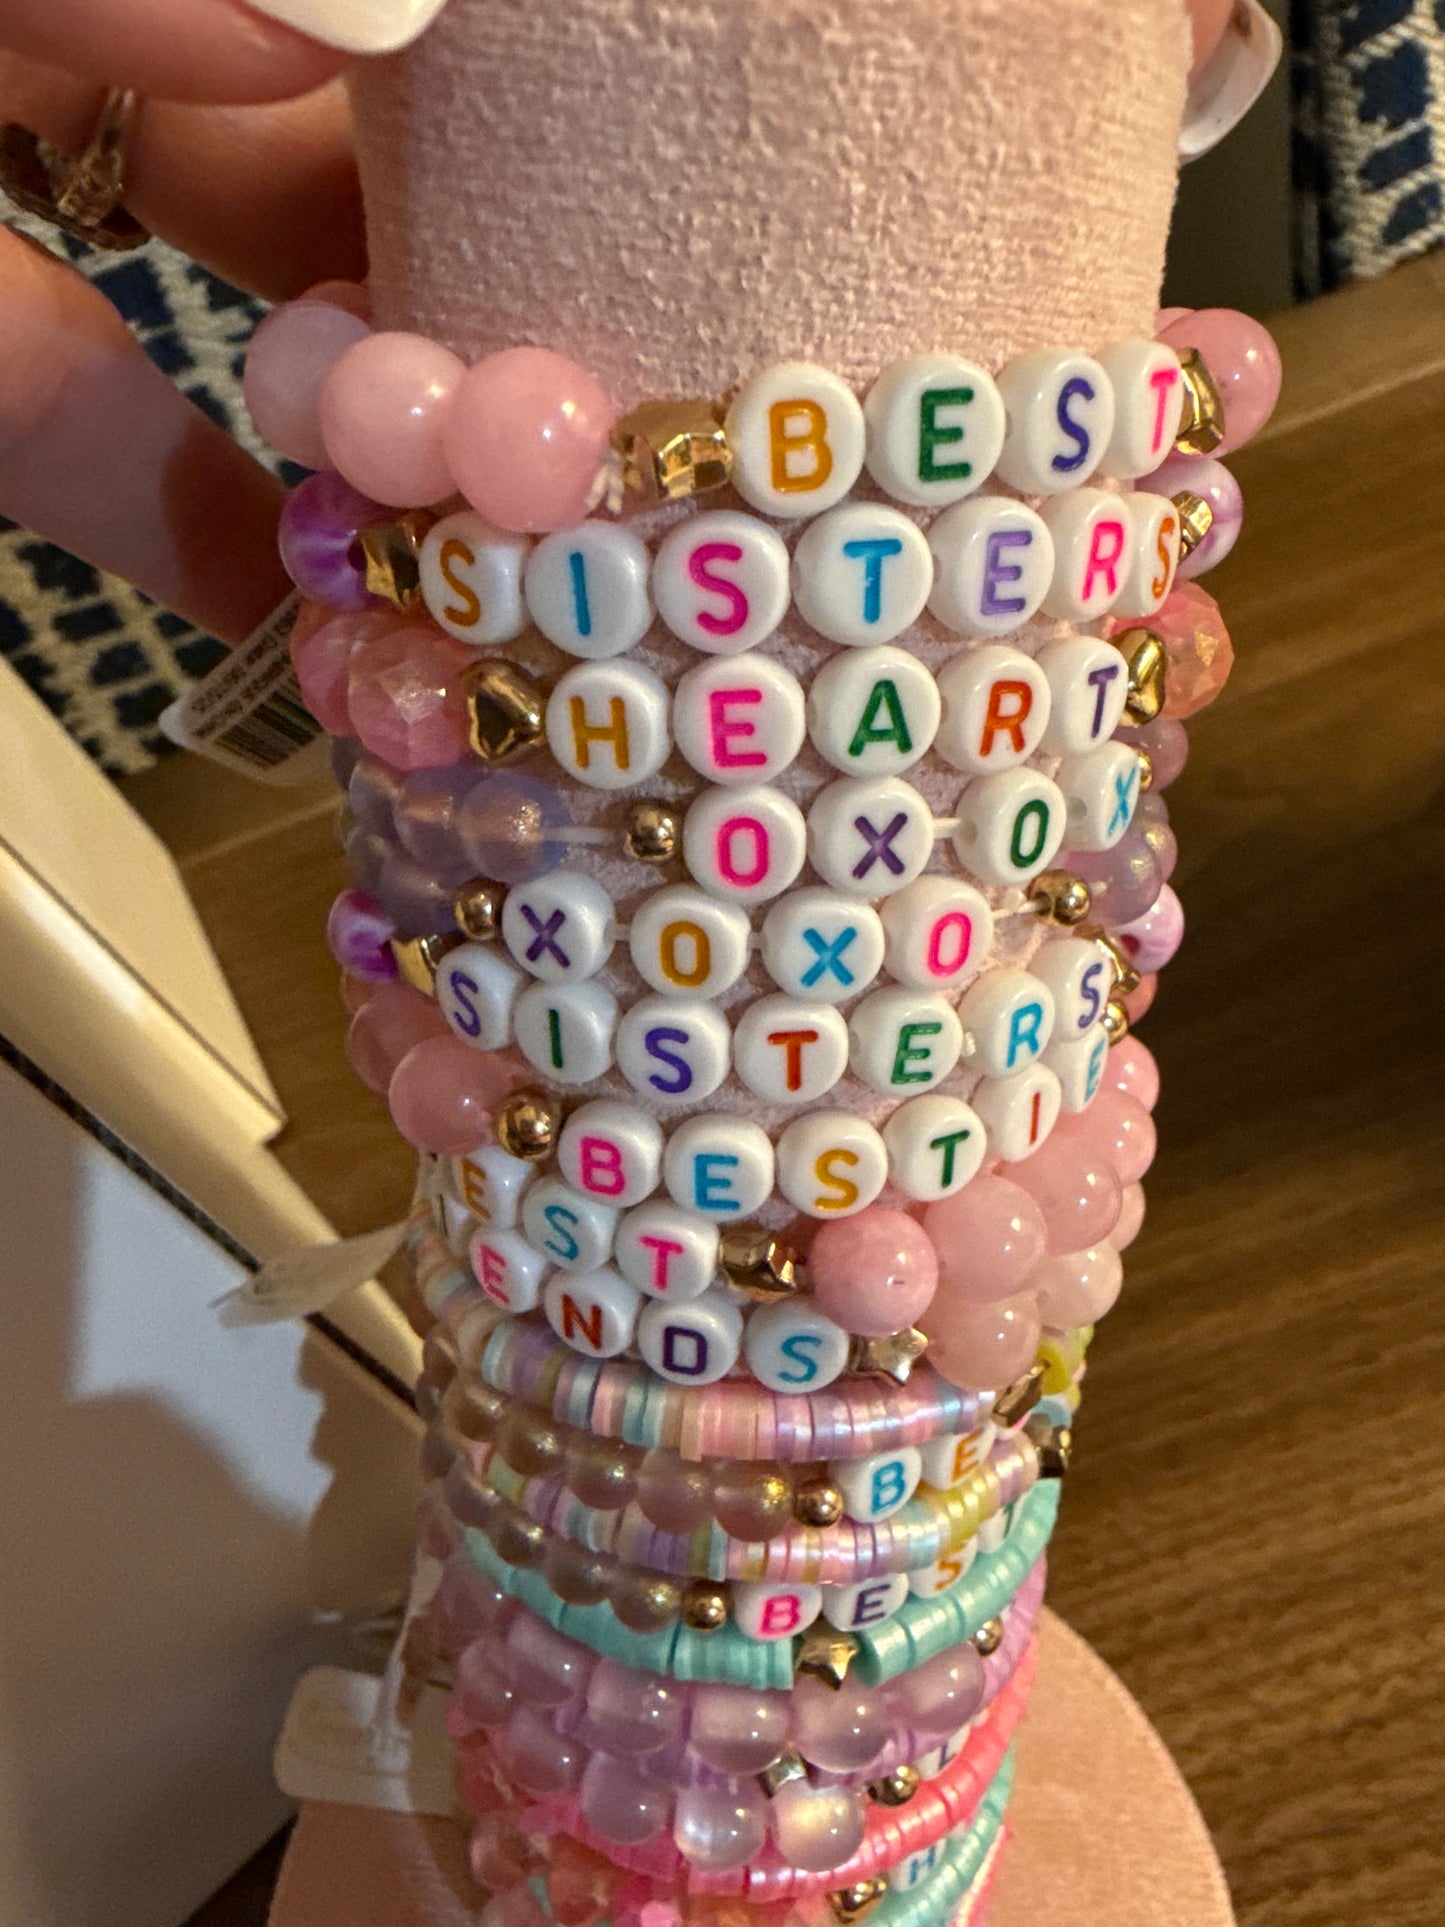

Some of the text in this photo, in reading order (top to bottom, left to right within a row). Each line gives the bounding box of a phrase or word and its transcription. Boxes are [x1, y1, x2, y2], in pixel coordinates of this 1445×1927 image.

[768, 367, 1178, 493] BEST
[439, 516, 1176, 638] SISTERS
[571, 665, 1119, 770] HEART
[716, 765, 1138, 888] OXOX
[519, 903, 973, 988] XOXO
[448, 962, 1103, 1095] SISTERS
